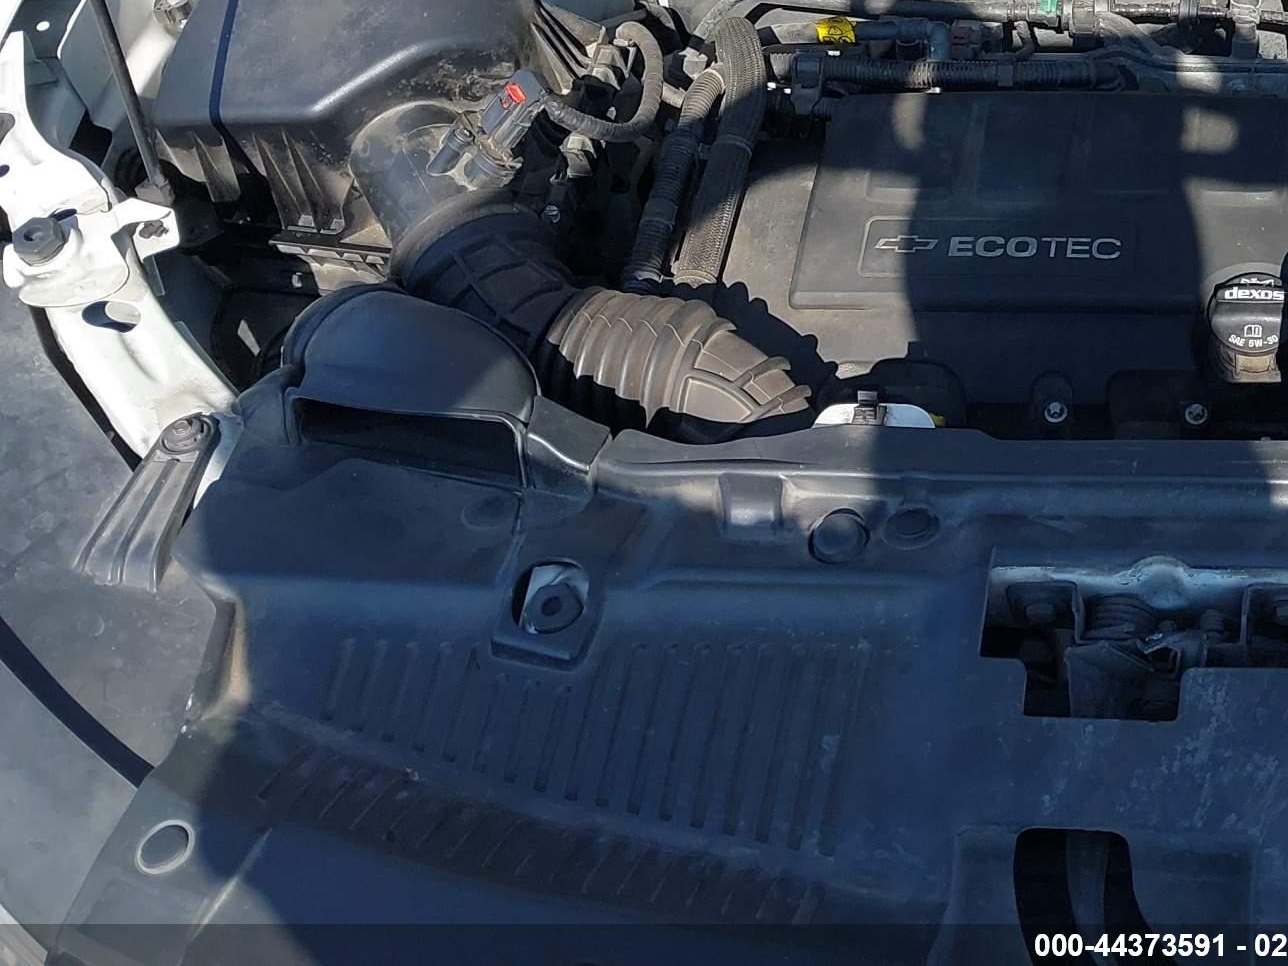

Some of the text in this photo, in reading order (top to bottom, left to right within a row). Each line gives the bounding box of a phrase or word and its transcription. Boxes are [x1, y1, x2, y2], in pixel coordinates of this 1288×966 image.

[947, 235, 1122, 260] ECOTEC
[1223, 286, 1285, 302] dexos
[1228, 333, 1279, 348] SAE 5W-30
